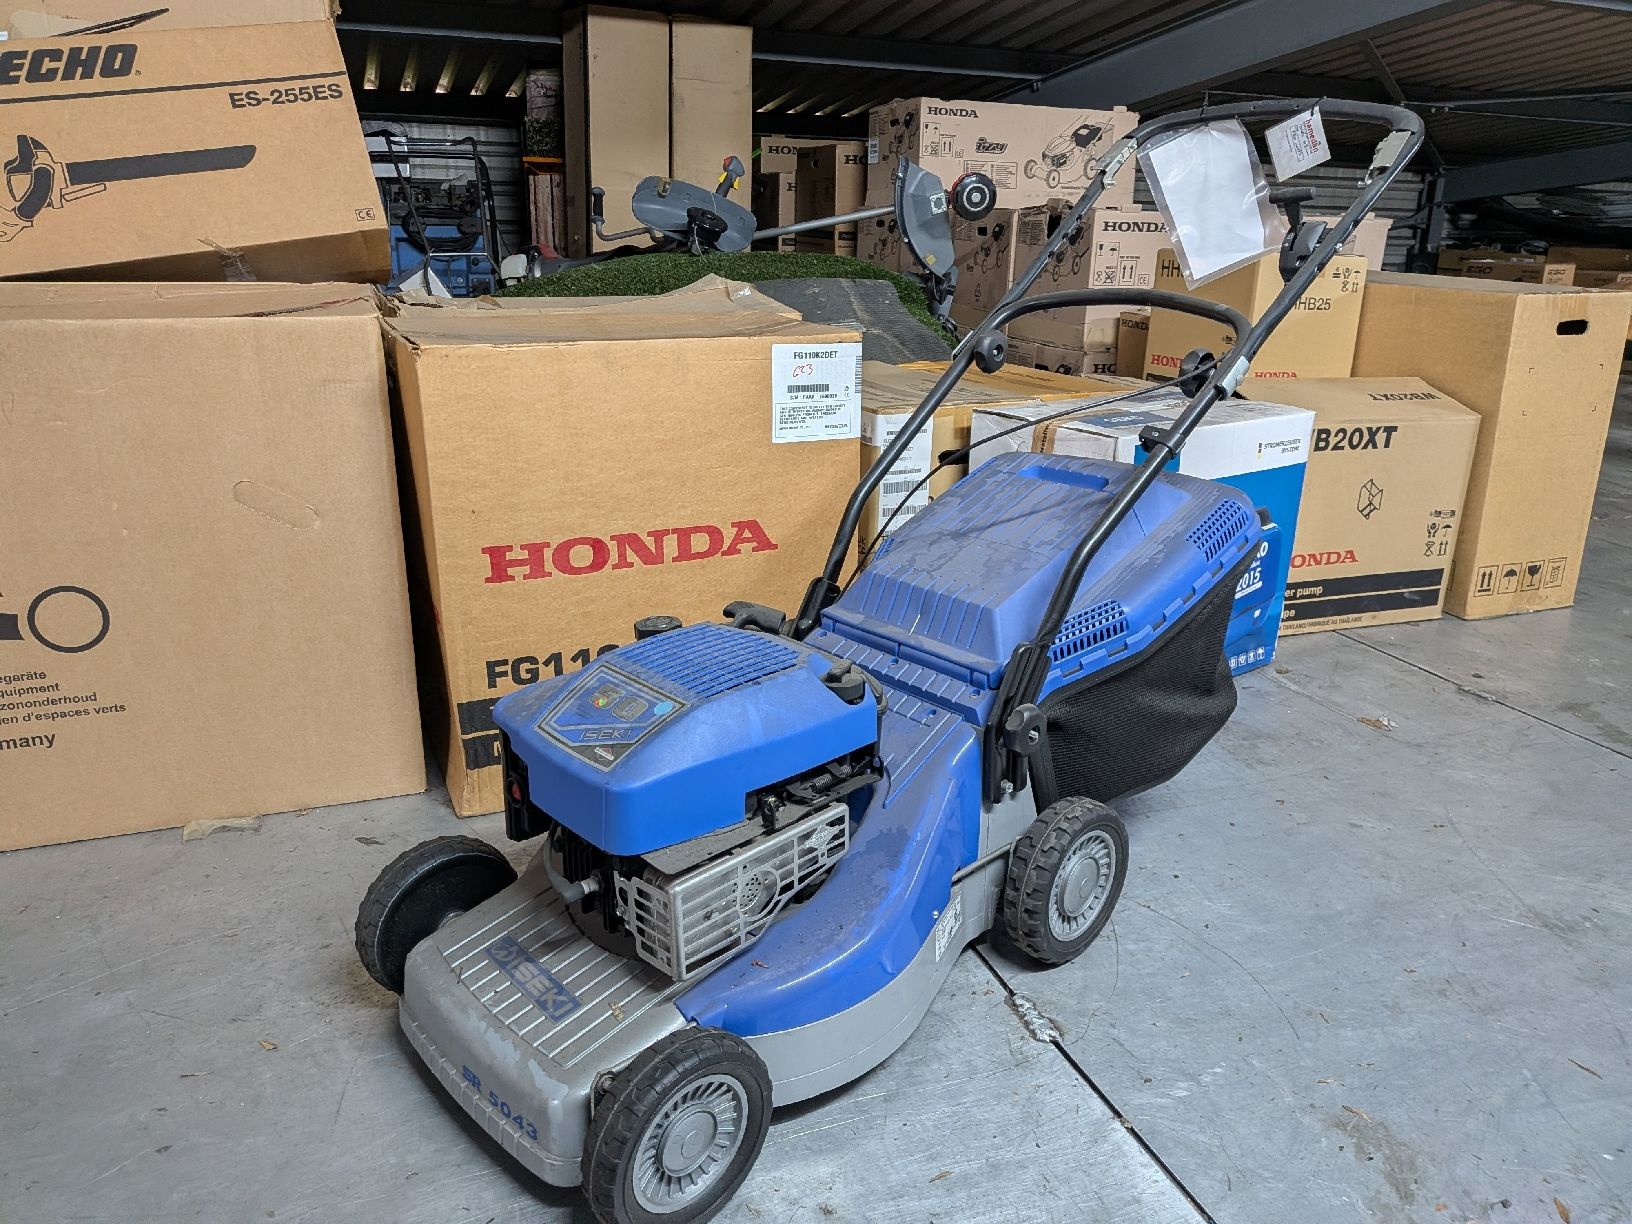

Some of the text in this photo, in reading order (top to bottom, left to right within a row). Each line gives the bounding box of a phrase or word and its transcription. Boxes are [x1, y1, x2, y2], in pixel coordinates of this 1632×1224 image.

[0, 43, 139, 85] ECHO
[229, 82, 345, 109] ES-255ES
[927, 106, 979, 119] HONDA
[1102, 221, 1168, 233] HONDA
[1161, 259, 1183, 277] HH
[793, 351, 838, 359] FG110K2DET
[1312, 425, 1398, 452] B20XT
[481, 519, 778, 584] HONDA
[1236, 567, 1261, 592] 2015
[1297, 585, 1323, 597] pump
[0, 692, 98, 711] zononderhoud
[22, 708, 91, 722] d'espaces
[93, 703, 127, 715] verts
[579, 729, 632, 741] ISEKI
[507, 956, 575, 1017] ISEKI
[463, 1065, 538, 1140] SR 5043
